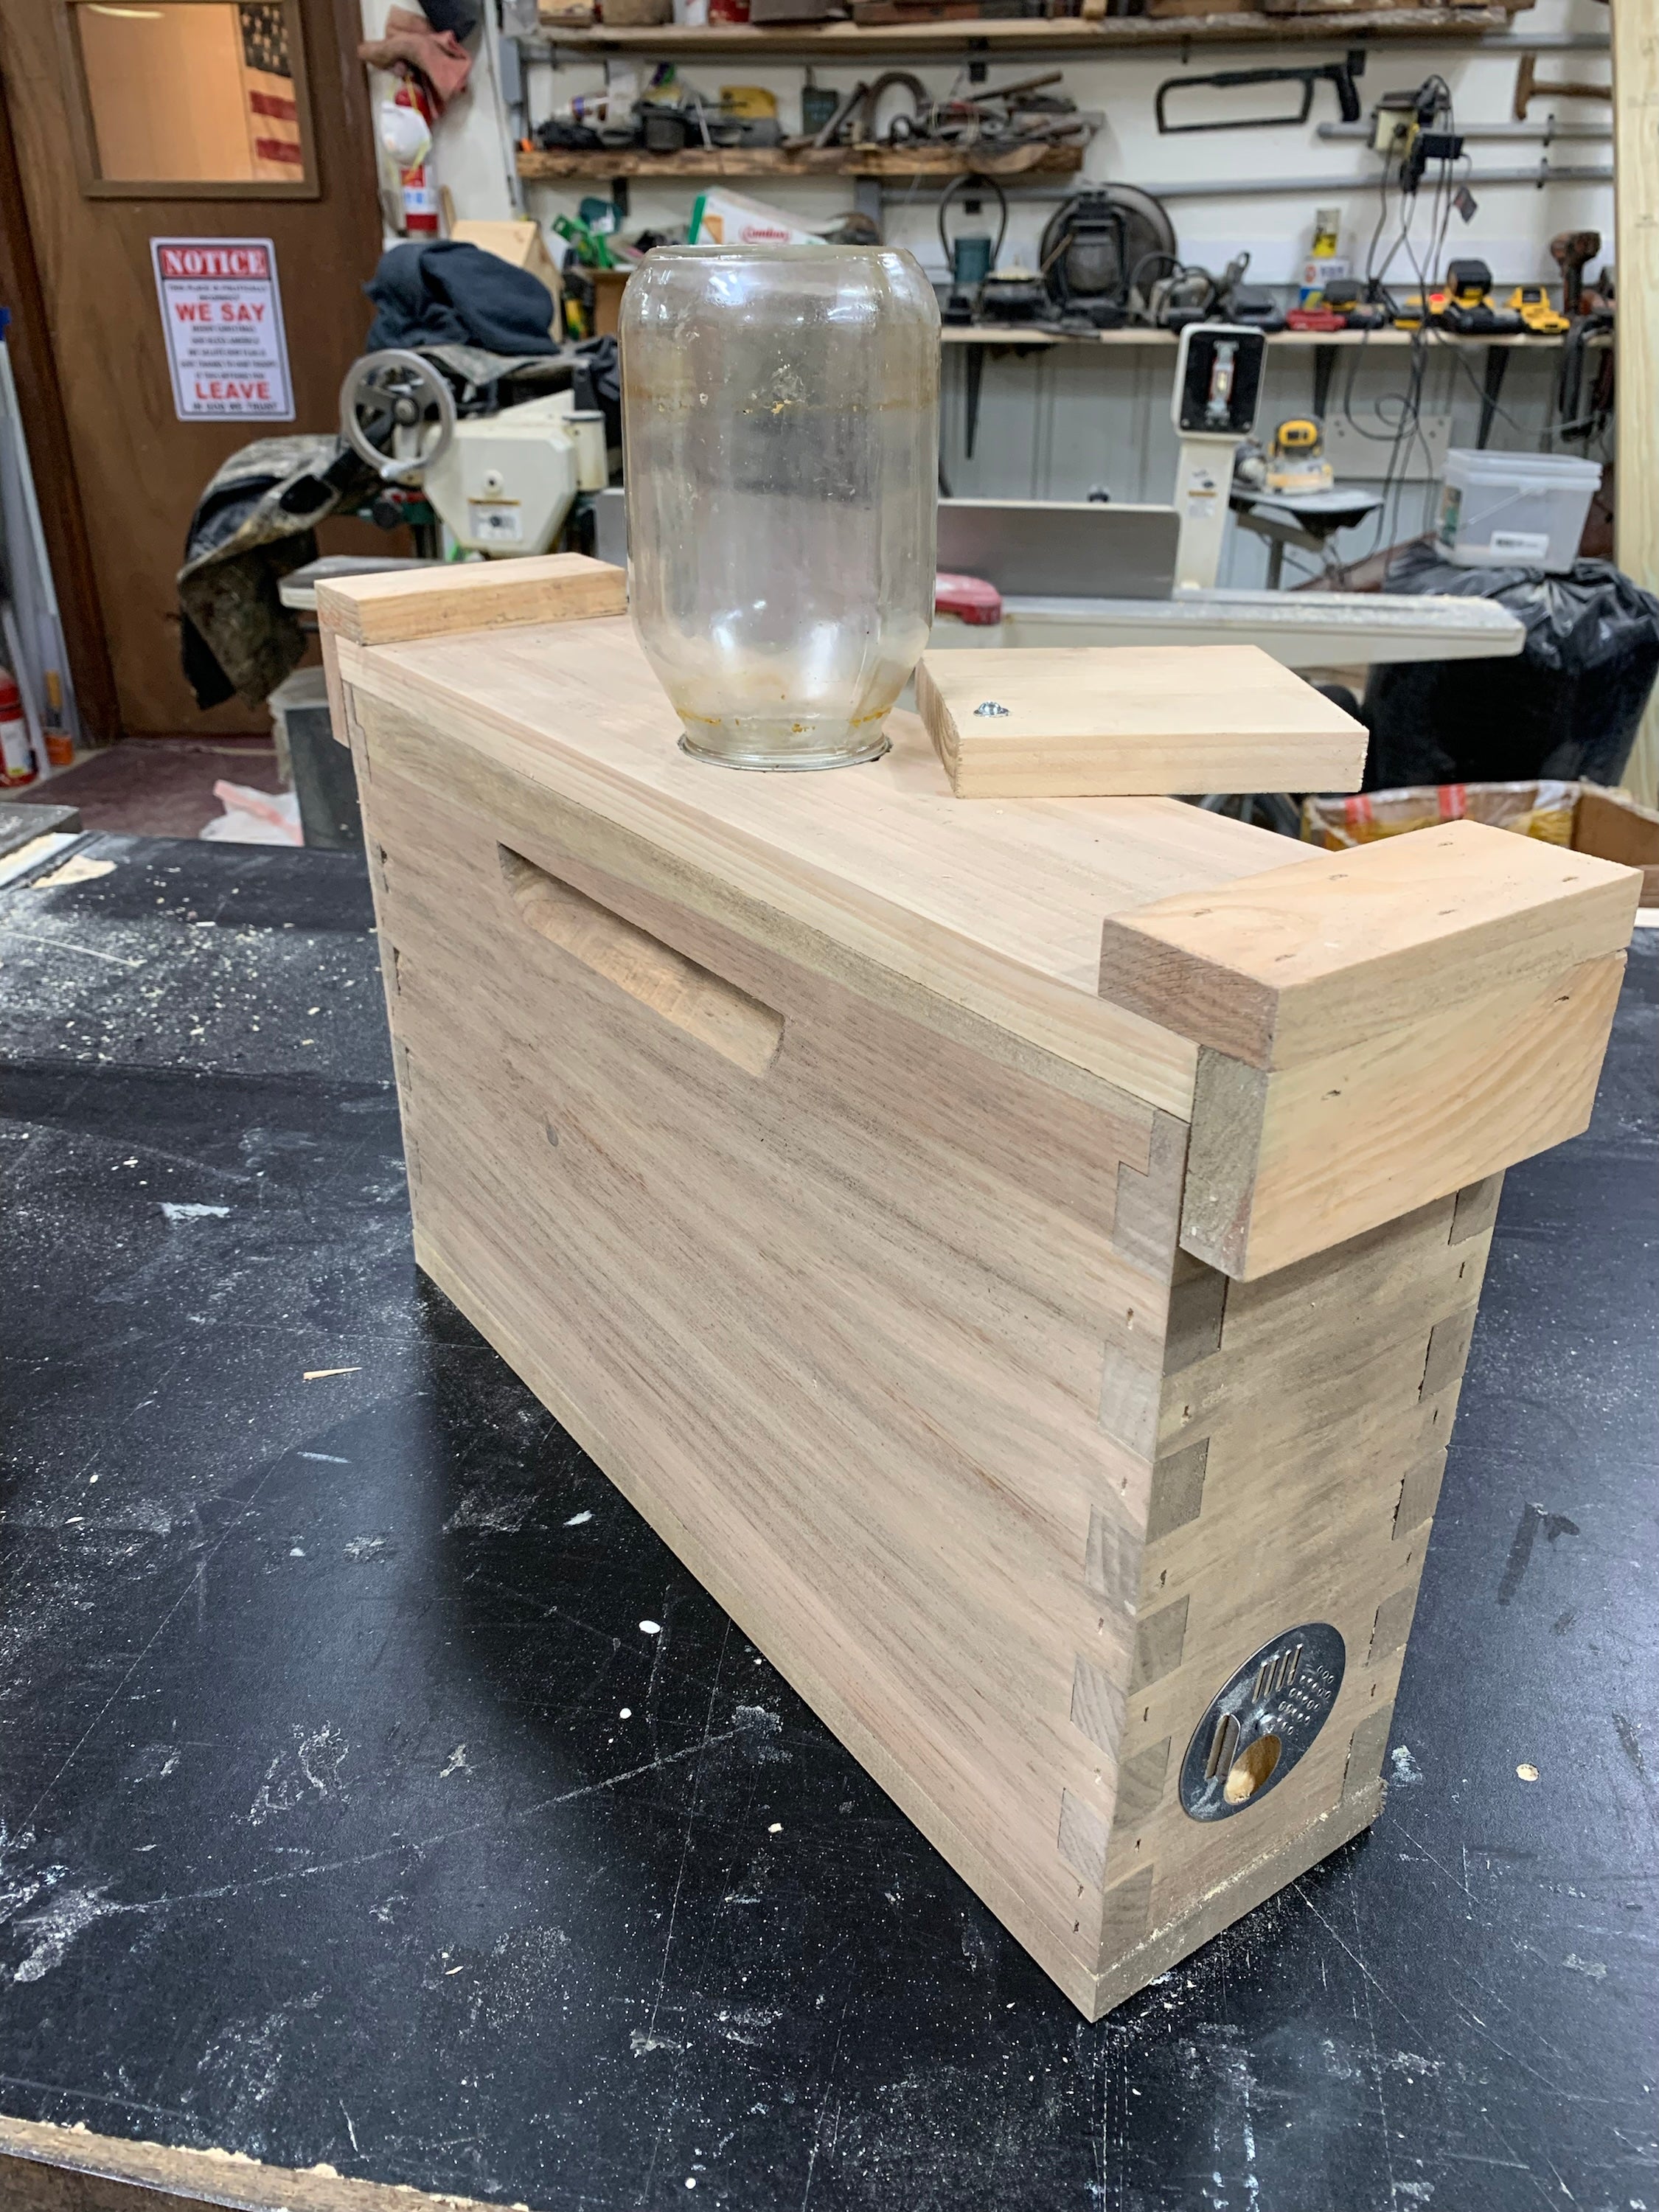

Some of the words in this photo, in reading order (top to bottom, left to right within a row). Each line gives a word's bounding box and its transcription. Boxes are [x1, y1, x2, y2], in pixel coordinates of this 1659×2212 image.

[164, 249, 268, 274] NOTICE
[175, 303, 212, 322] WE
[221, 303, 265, 322] SAY
[195, 381, 271, 400] LEAVE
